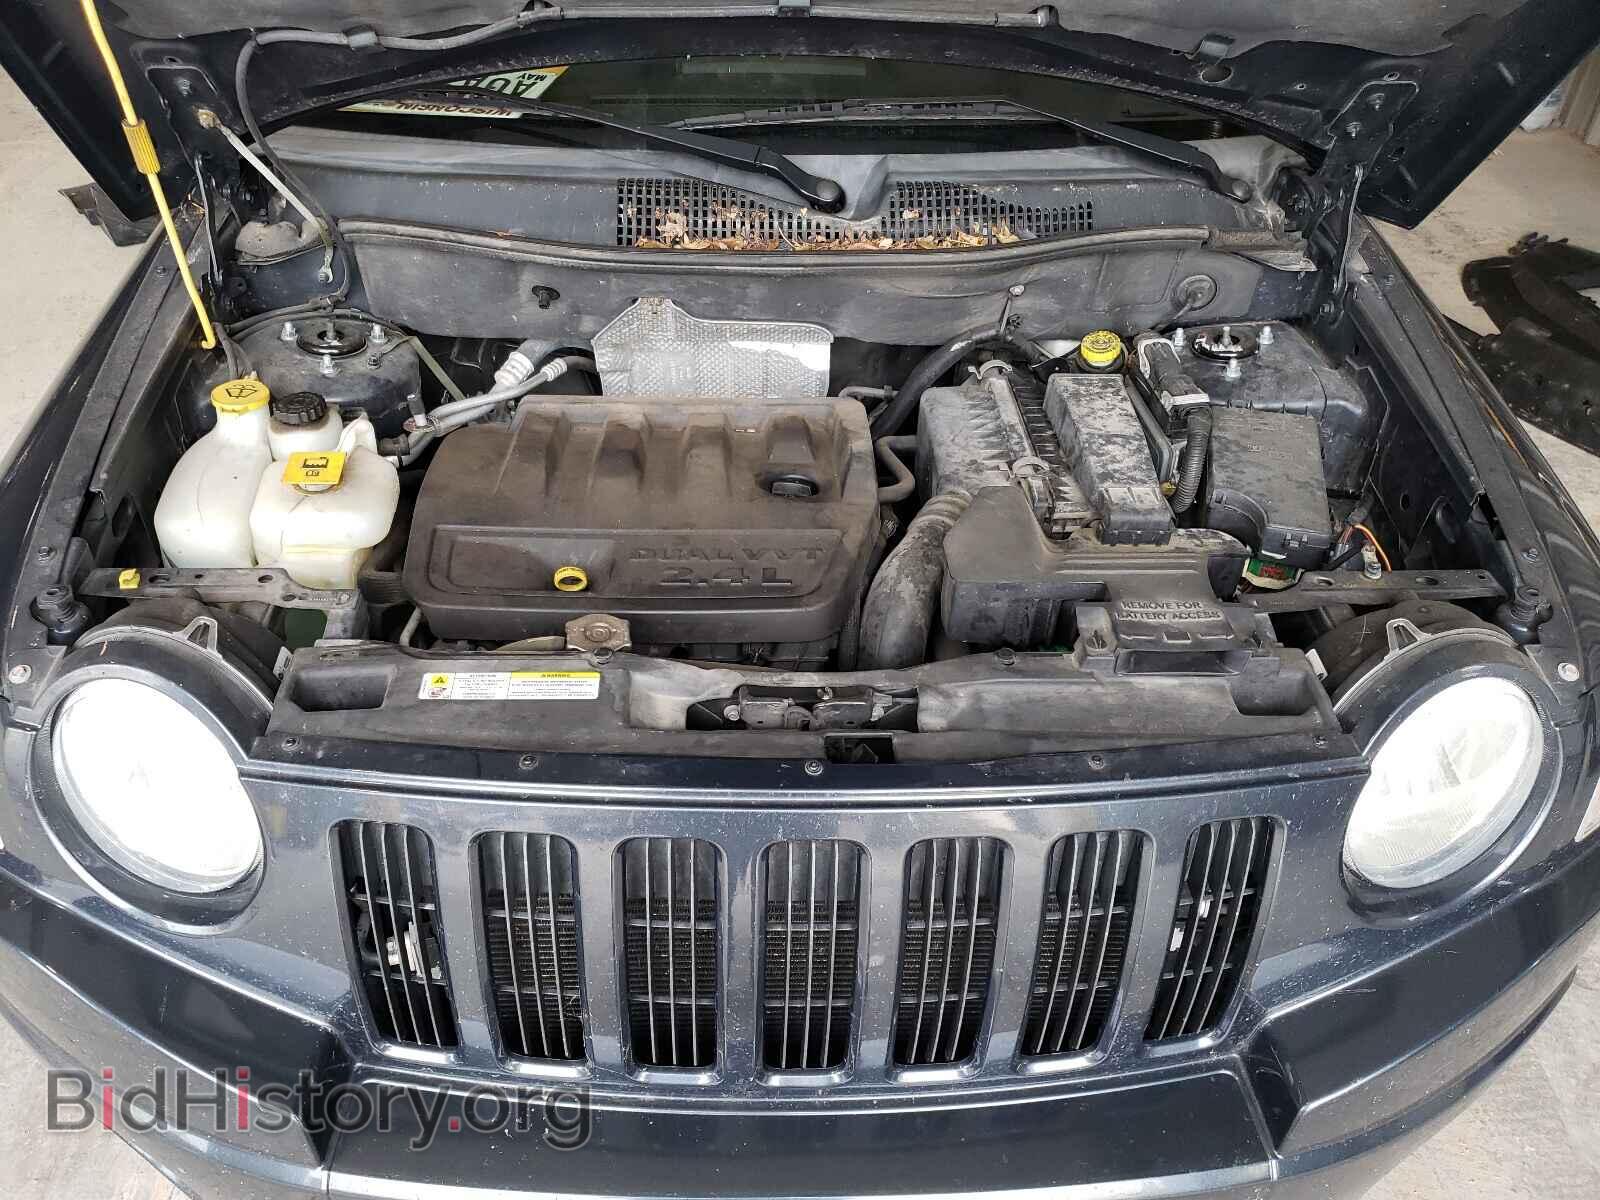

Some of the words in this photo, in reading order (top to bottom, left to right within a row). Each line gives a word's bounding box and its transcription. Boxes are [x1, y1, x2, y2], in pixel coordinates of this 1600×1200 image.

[517, 72, 548, 82] MAY
[629, 548, 735, 562] DUAL
[1121, 600, 1174, 610] REMOVE
[1176, 600, 1202, 610] FOR
[1116, 611, 1168, 621] BATTERY
[1171, 611, 1222, 621] ACCESS
